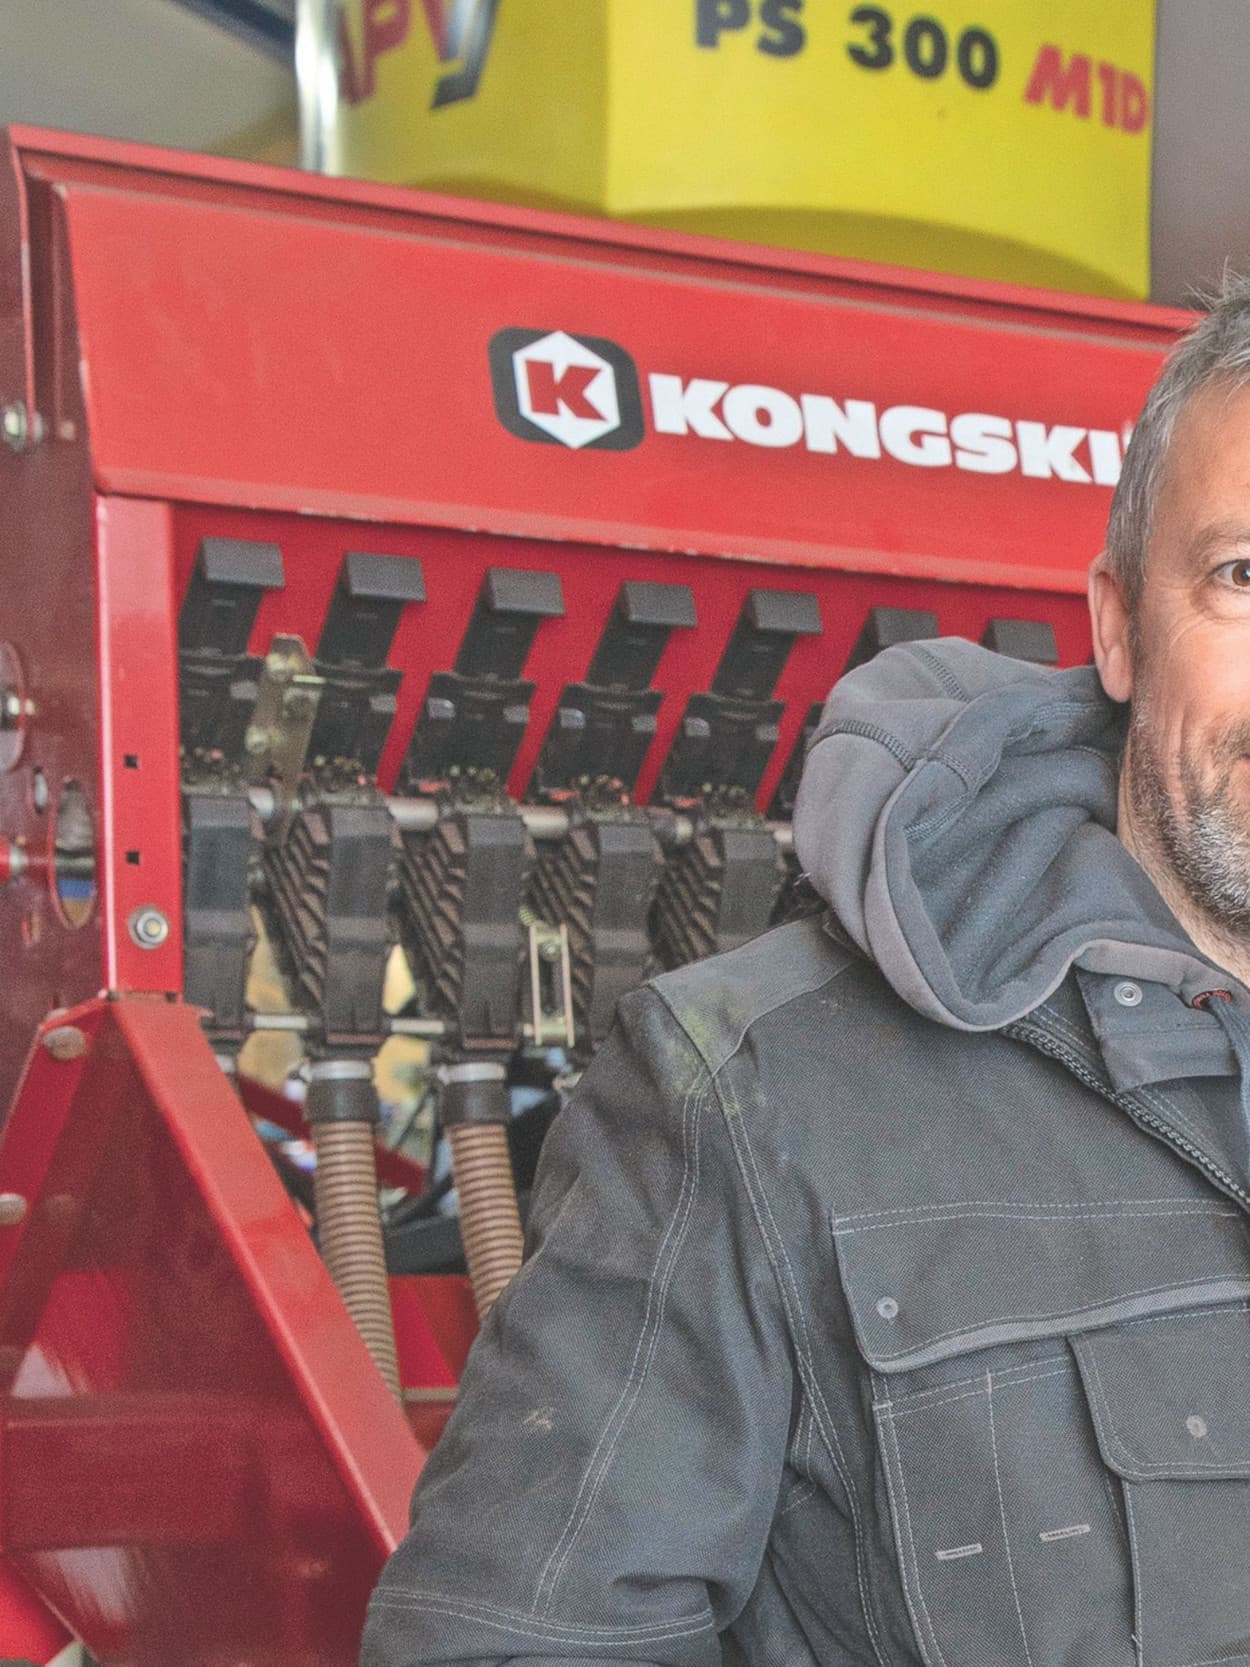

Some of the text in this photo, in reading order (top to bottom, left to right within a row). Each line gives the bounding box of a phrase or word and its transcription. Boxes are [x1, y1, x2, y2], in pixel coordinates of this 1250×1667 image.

[694, 0, 806, 57] PS
[847, 4, 1000, 91] 300
[525, 359, 1133, 487] K KONGSKI
